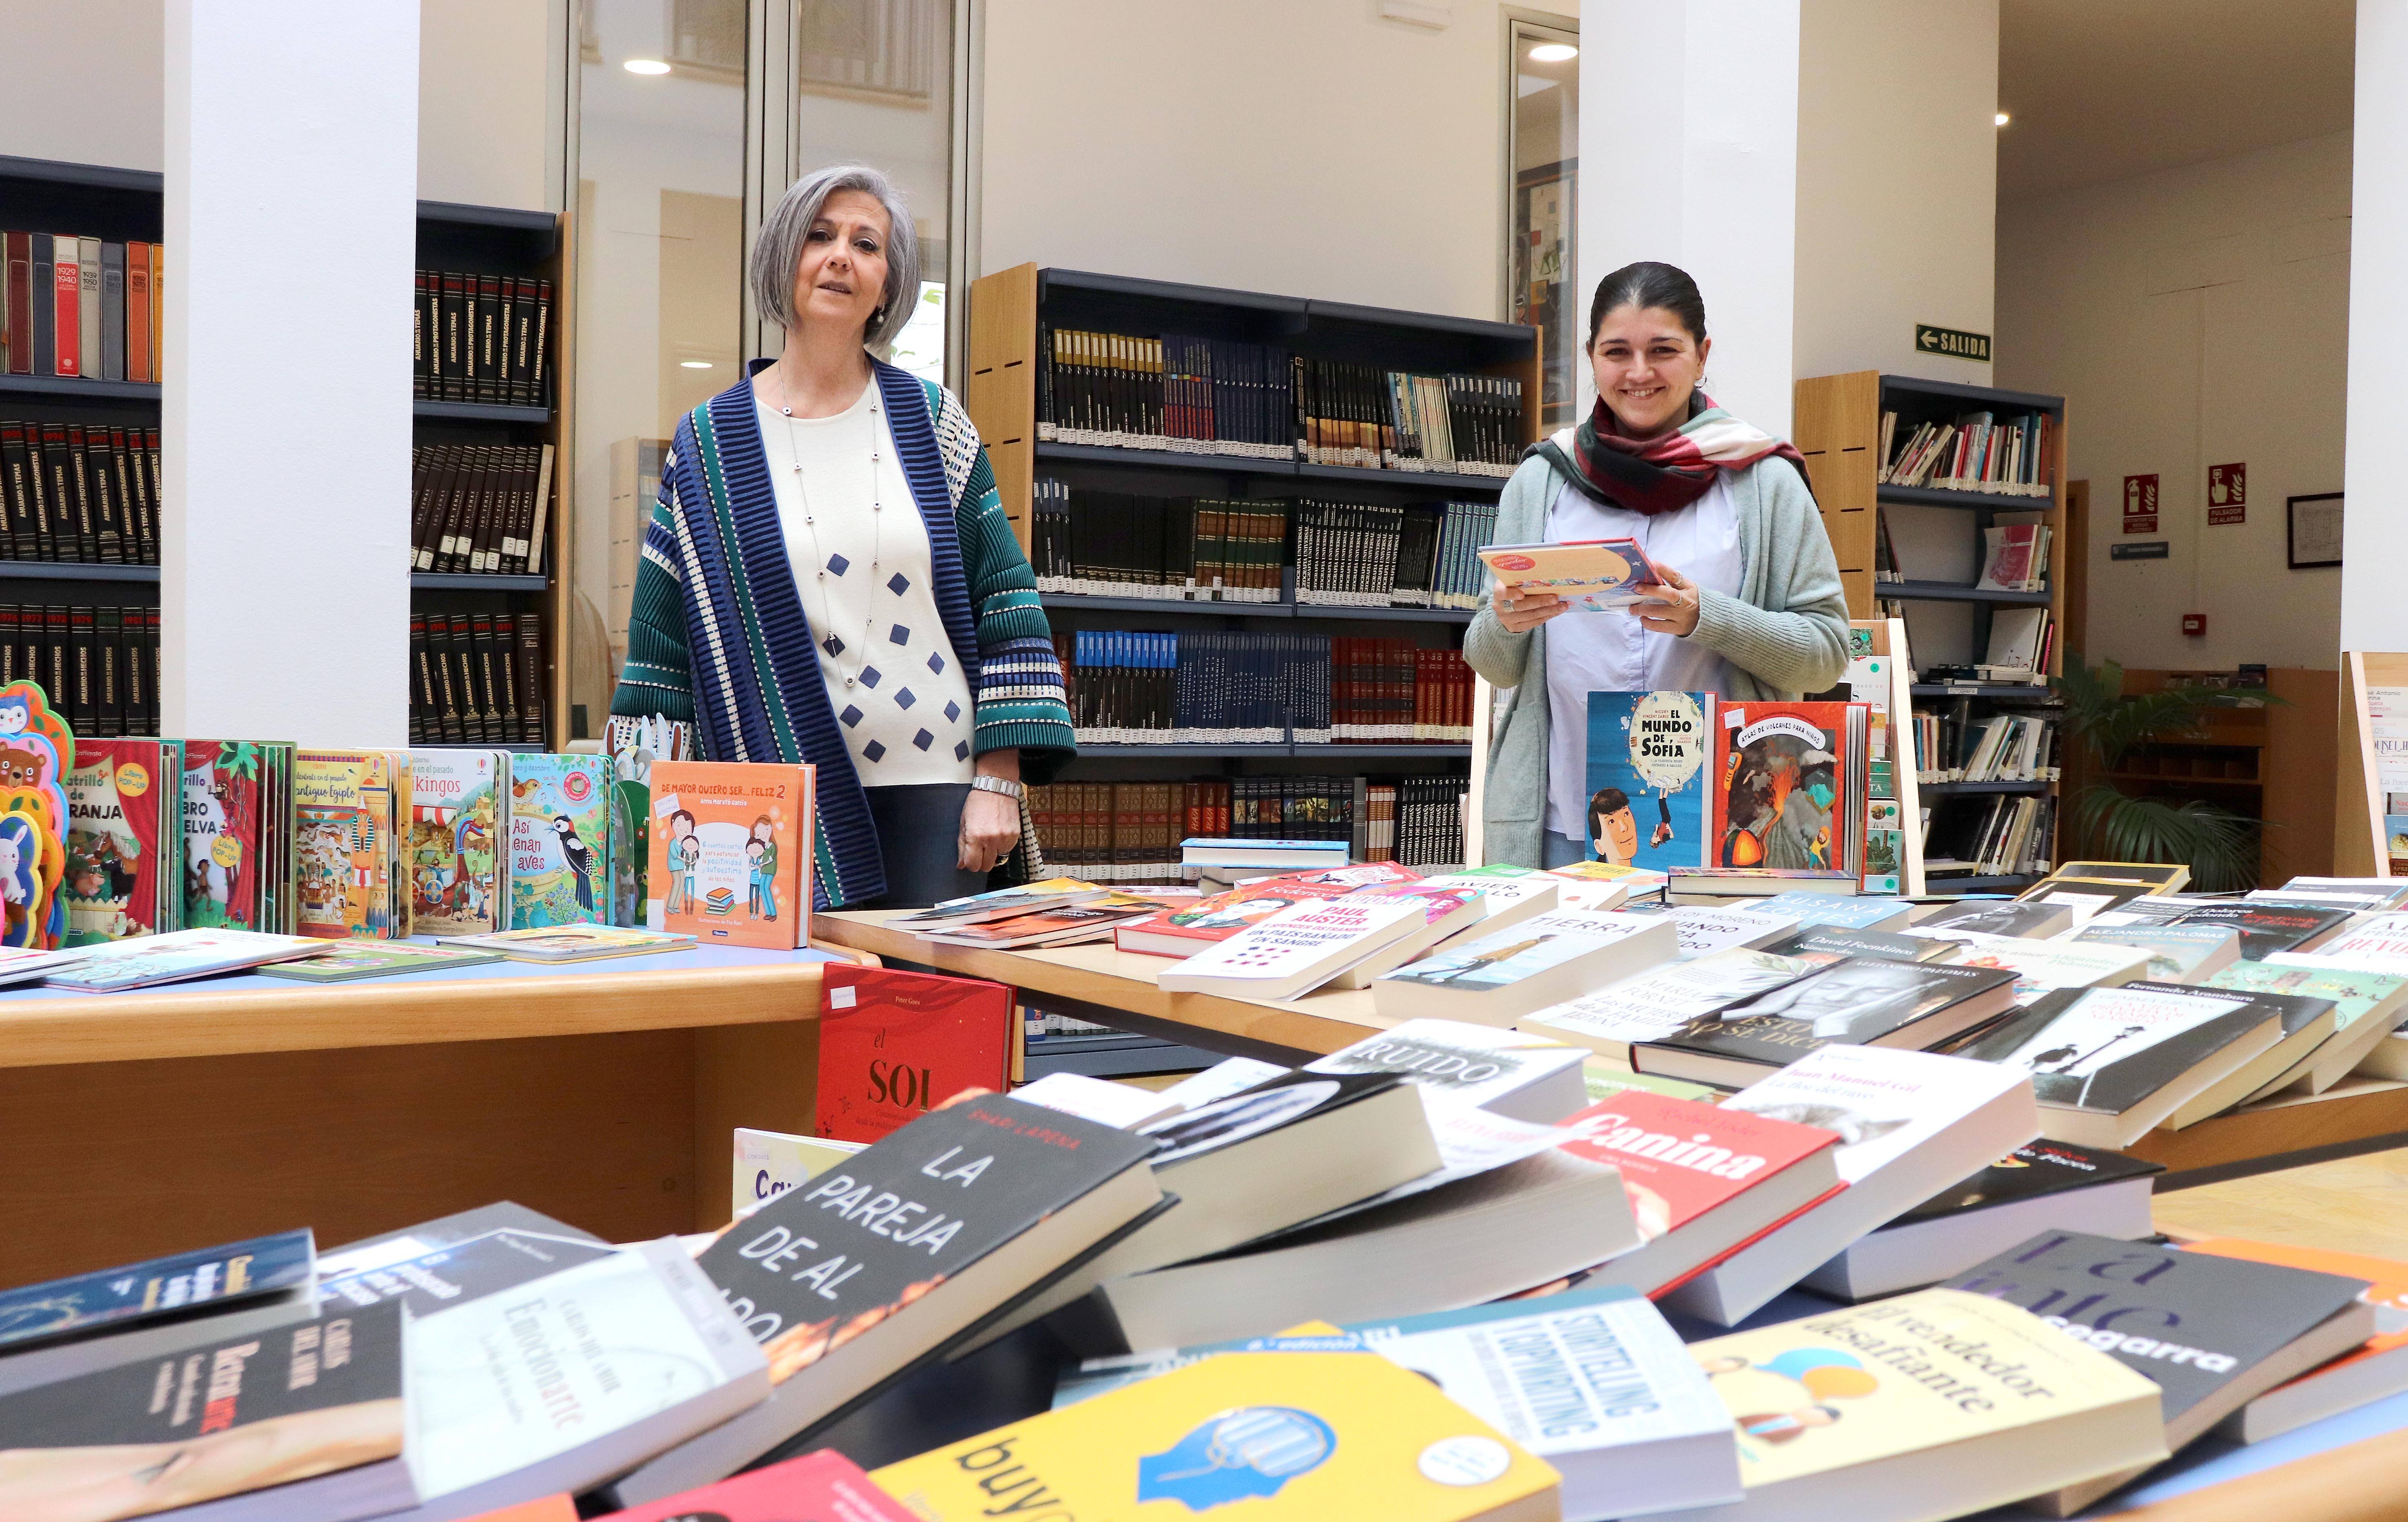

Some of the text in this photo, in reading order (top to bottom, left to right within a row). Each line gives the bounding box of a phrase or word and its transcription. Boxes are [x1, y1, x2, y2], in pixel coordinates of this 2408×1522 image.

[57, 276, 77, 284] 1940
[1941, 332, 1987, 356] SALIDA
[16, 489, 27, 518] ANUARIO
[58, 492, 68, 520] ANUARIO
[1671, 710, 1680, 718] EL
[1642, 721, 1691, 732] MUNDO
[1742, 730, 1756, 743] ATLAS
[1793, 723, 1805, 734] PARA
[426, 765, 432, 773] el
[433, 765, 453, 774] pasado
[118, 777, 146, 788] POP-UP
[185, 774, 205, 786] rillo
[413, 776, 460, 797] ikingos
[70, 788, 84, 800] de
[330, 786, 355, 803] Egipto
[661, 783, 786, 799] DE MAYOR QUIERO SER... FELIZ 2
[70, 804, 122, 819] RANJA
[185, 820, 216, 834] ELVA
[513, 819, 531, 834] Así
[218, 839, 234, 851] Libro
[512, 838, 541, 853] enan
[212, 847, 236, 861] POP-UP
[708, 858, 741, 866] positividad
[518, 855, 545, 871] aves
[1264, 886, 1335, 897] Federico
[1440, 882, 1519, 891] JAVIER
[1338, 894, 1455, 909] INDOMABLE
[1772, 895, 1884, 915] SUSANA
[1320, 906, 1370, 916] PAUL
[1670, 910, 1771, 926] ELOY MORENO
[1759, 905, 1860, 924] FORTES
[1291, 914, 1369, 926] AUSTER
[1530, 917, 1638, 934] TIERRA
[1270, 938, 1326, 946] SANGRE
[2164, 930, 2226, 939] PALOMAS
[1794, 943, 1834, 953] Número
[1809, 937, 1916, 957] David Foenkinos
[1921, 967, 1980, 977] PALOMAS
[895, 995, 908, 1004] Peter
[1621, 987, 1693, 1006] FORNET
[2126, 982, 2255, 1002] Fernando Aramburu
[1594, 995, 1691, 1020] Las MUJERES
[1688, 1021, 1724, 1037] NO
[1722, 1025, 1758, 1039] SE
[1738, 1015, 1814, 1034] ESTO
[874, 1028, 886, 1049] el
[1353, 1042, 1501, 1084] RUIDO
[1785, 1068, 1923, 1093] Juan Manuel Gil
[1788, 1081, 1874, 1100] flor del rayo
[1572, 1113, 1766, 1180] Canina
[921, 1145, 994, 1188] LA
[803, 1175, 964, 1256] PAREJA
[738, 1226, 864, 1301] DE AL
[504, 1297, 588, 1431] Emocionarte
[1551, 1312, 1662, 1420] STORYTELLING
[1898, 1313, 2056, 1402] vendedor
[1803, 1318, 1995, 1415] desafiante
[1502, 1337, 1600, 1439] COPYWRITING
